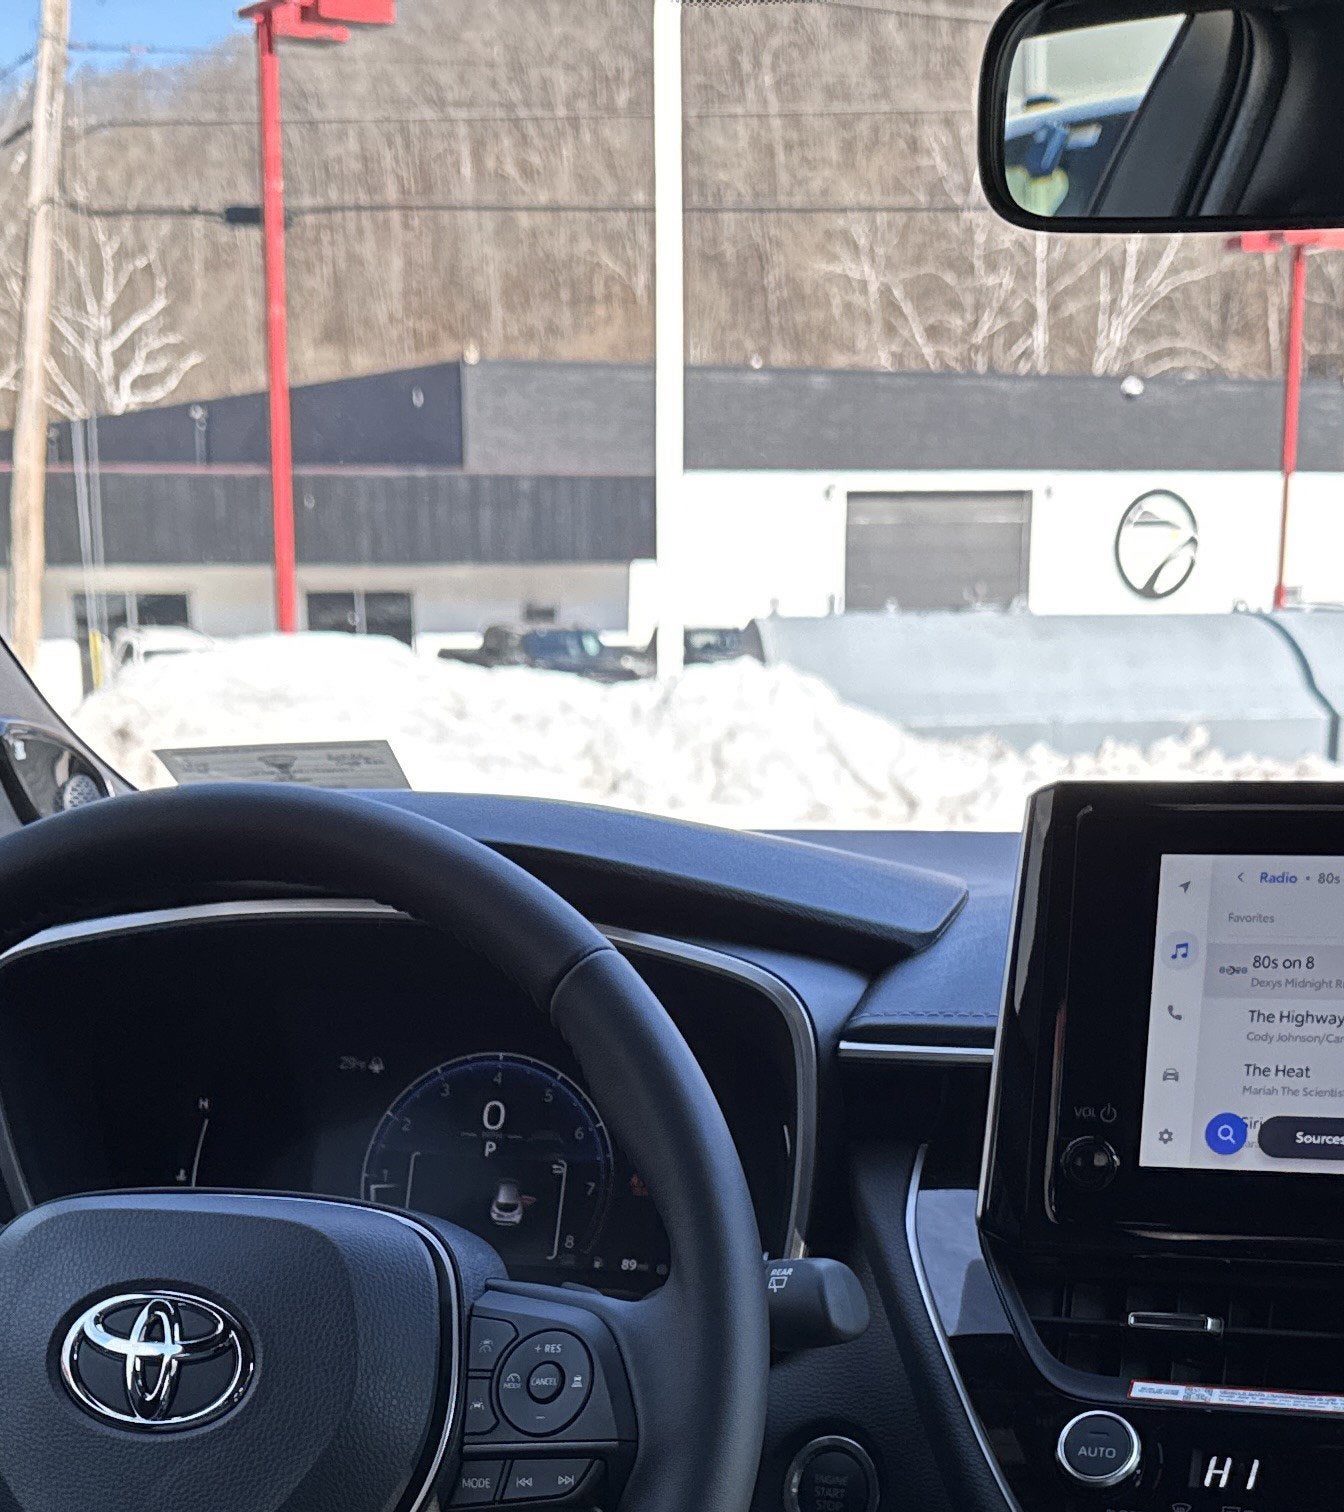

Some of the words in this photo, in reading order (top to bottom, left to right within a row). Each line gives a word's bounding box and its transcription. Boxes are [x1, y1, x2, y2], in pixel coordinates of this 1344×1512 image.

[1259, 872, 1298, 884] Radio
[1318, 872, 1340, 885] 80s
[1228, 912, 1275, 924] Favorites
[1252, 956, 1278, 970] 80s
[1282, 958, 1302, 970] on
[1305, 956, 1315, 970] 8
[1251, 978, 1282, 990] Dexys
[1285, 978, 1333, 990] Midnight
[1249, 1010, 1276, 1024] The
[1246, 1032, 1273, 1044] Cody
[1244, 1063, 1271, 1078] The
[1274, 1064, 1311, 1079] Heat
[493, 1072, 503, 1084] 4
[440, 1083, 451, 1097] 3
[1242, 1085, 1278, 1096] Mariah
[1281, 1086, 1299, 1097] The
[483, 1100, 506, 1130] 0
[1074, 1105, 1097, 1118] VOL
[574, 1127, 585, 1140] 6
[484, 1141, 497, 1157] P
[585, 1182, 596, 1196] 7
[564, 1235, 575, 1249] 8
[620, 1258, 637, 1271] 89
[770, 1267, 793, 1277] REAR
[544, 1344, 562, 1353] RES
[530, 1377, 558, 1386] CANCEL
[1077, 1446, 1117, 1460] AUTO
[462, 1478, 491, 1489] MODE
